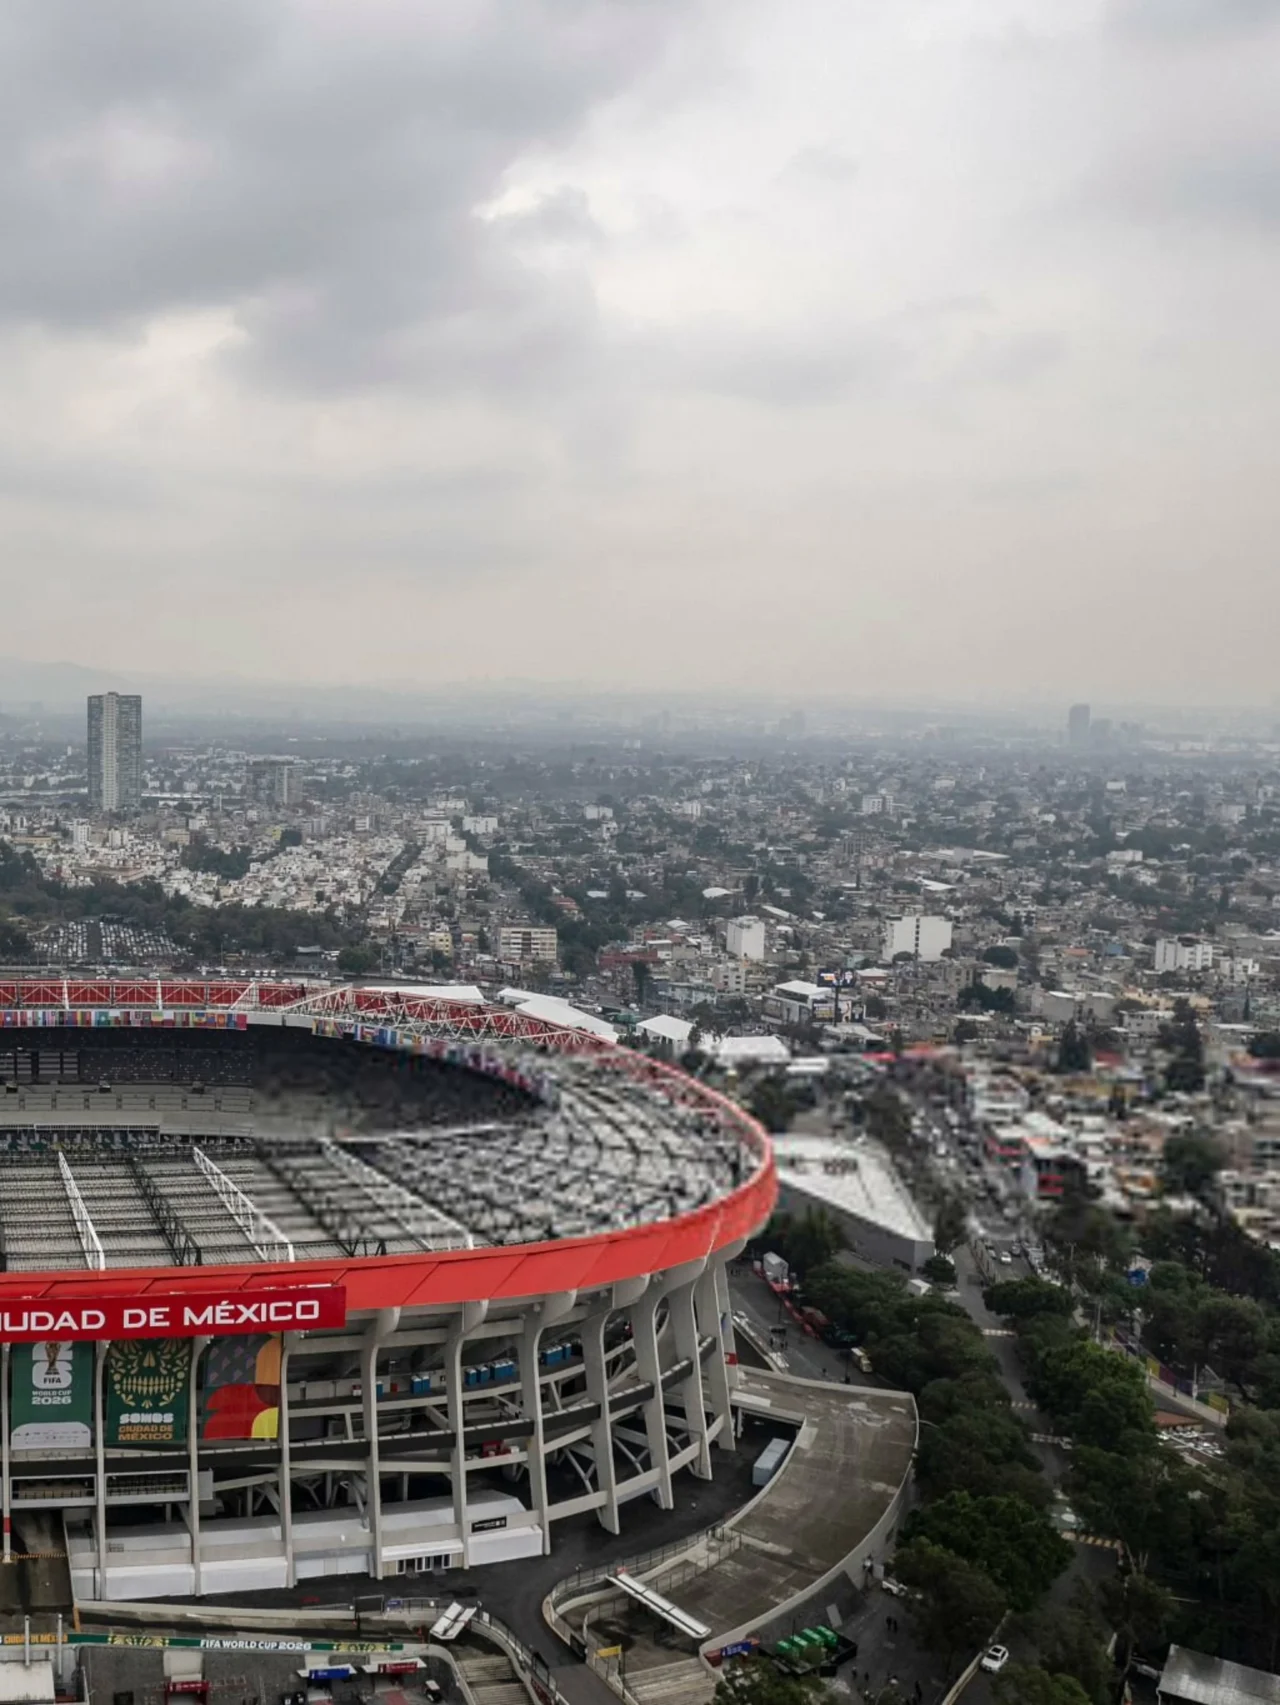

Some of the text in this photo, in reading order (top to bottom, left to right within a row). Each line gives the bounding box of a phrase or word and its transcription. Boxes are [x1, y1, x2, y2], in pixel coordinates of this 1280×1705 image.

[123, 1307, 170, 1328] DE
[183, 1300, 320, 1326] MÉXICO
[43, 1376, 62, 1384] FIFA
[31, 1396, 72, 1405] 2026
[119, 1413, 174, 1424] SOMOS
[119, 1424, 173, 1433] CIUDAD DE
[200, 1639, 312, 1650] FIFA WORLD CUP 2026
